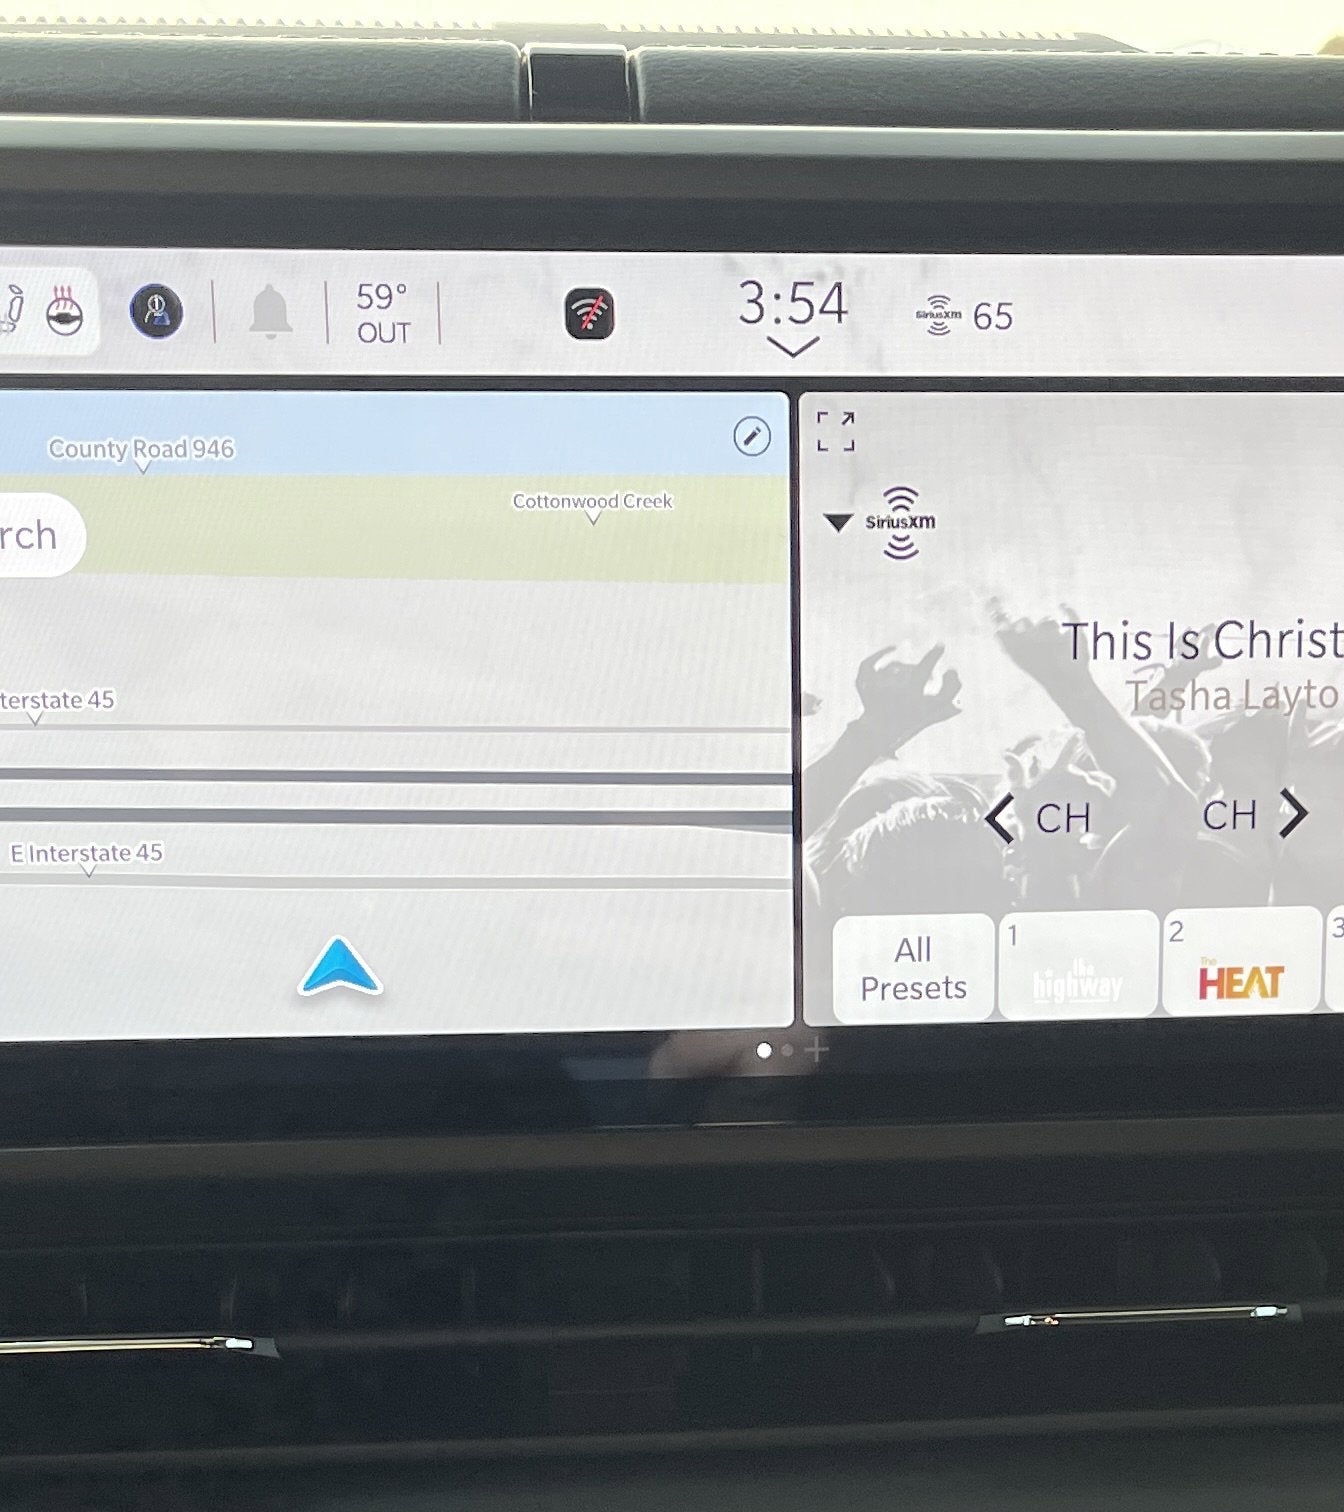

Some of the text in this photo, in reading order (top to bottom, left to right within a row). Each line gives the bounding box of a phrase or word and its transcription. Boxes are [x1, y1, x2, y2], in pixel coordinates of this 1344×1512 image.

[355, 283, 408, 311] 59°
[738, 280, 849, 325] 3:54
[973, 302, 1014, 330] 65
[357, 321, 412, 345] OUT
[48, 439, 235, 463] County Road 946
[513, 492, 673, 510] Cottonwood Creek
[1061, 619, 1152, 661] This
[1167, 620, 1200, 661] Is
[87, 690, 115, 709] 45
[1126, 679, 1231, 711] Tasha
[1035, 802, 1091, 834] CH
[1202, 799, 1257, 830] CH
[11, 843, 163, 863] E Interstate 45
[1007, 924, 1017, 946] 1
[1168, 920, 1185, 943] 2
[893, 935, 932, 963] All
[861, 975, 968, 1002] Presets
[1032, 968, 1124, 1002] highway
[1199, 965, 1286, 1000] HEAT
